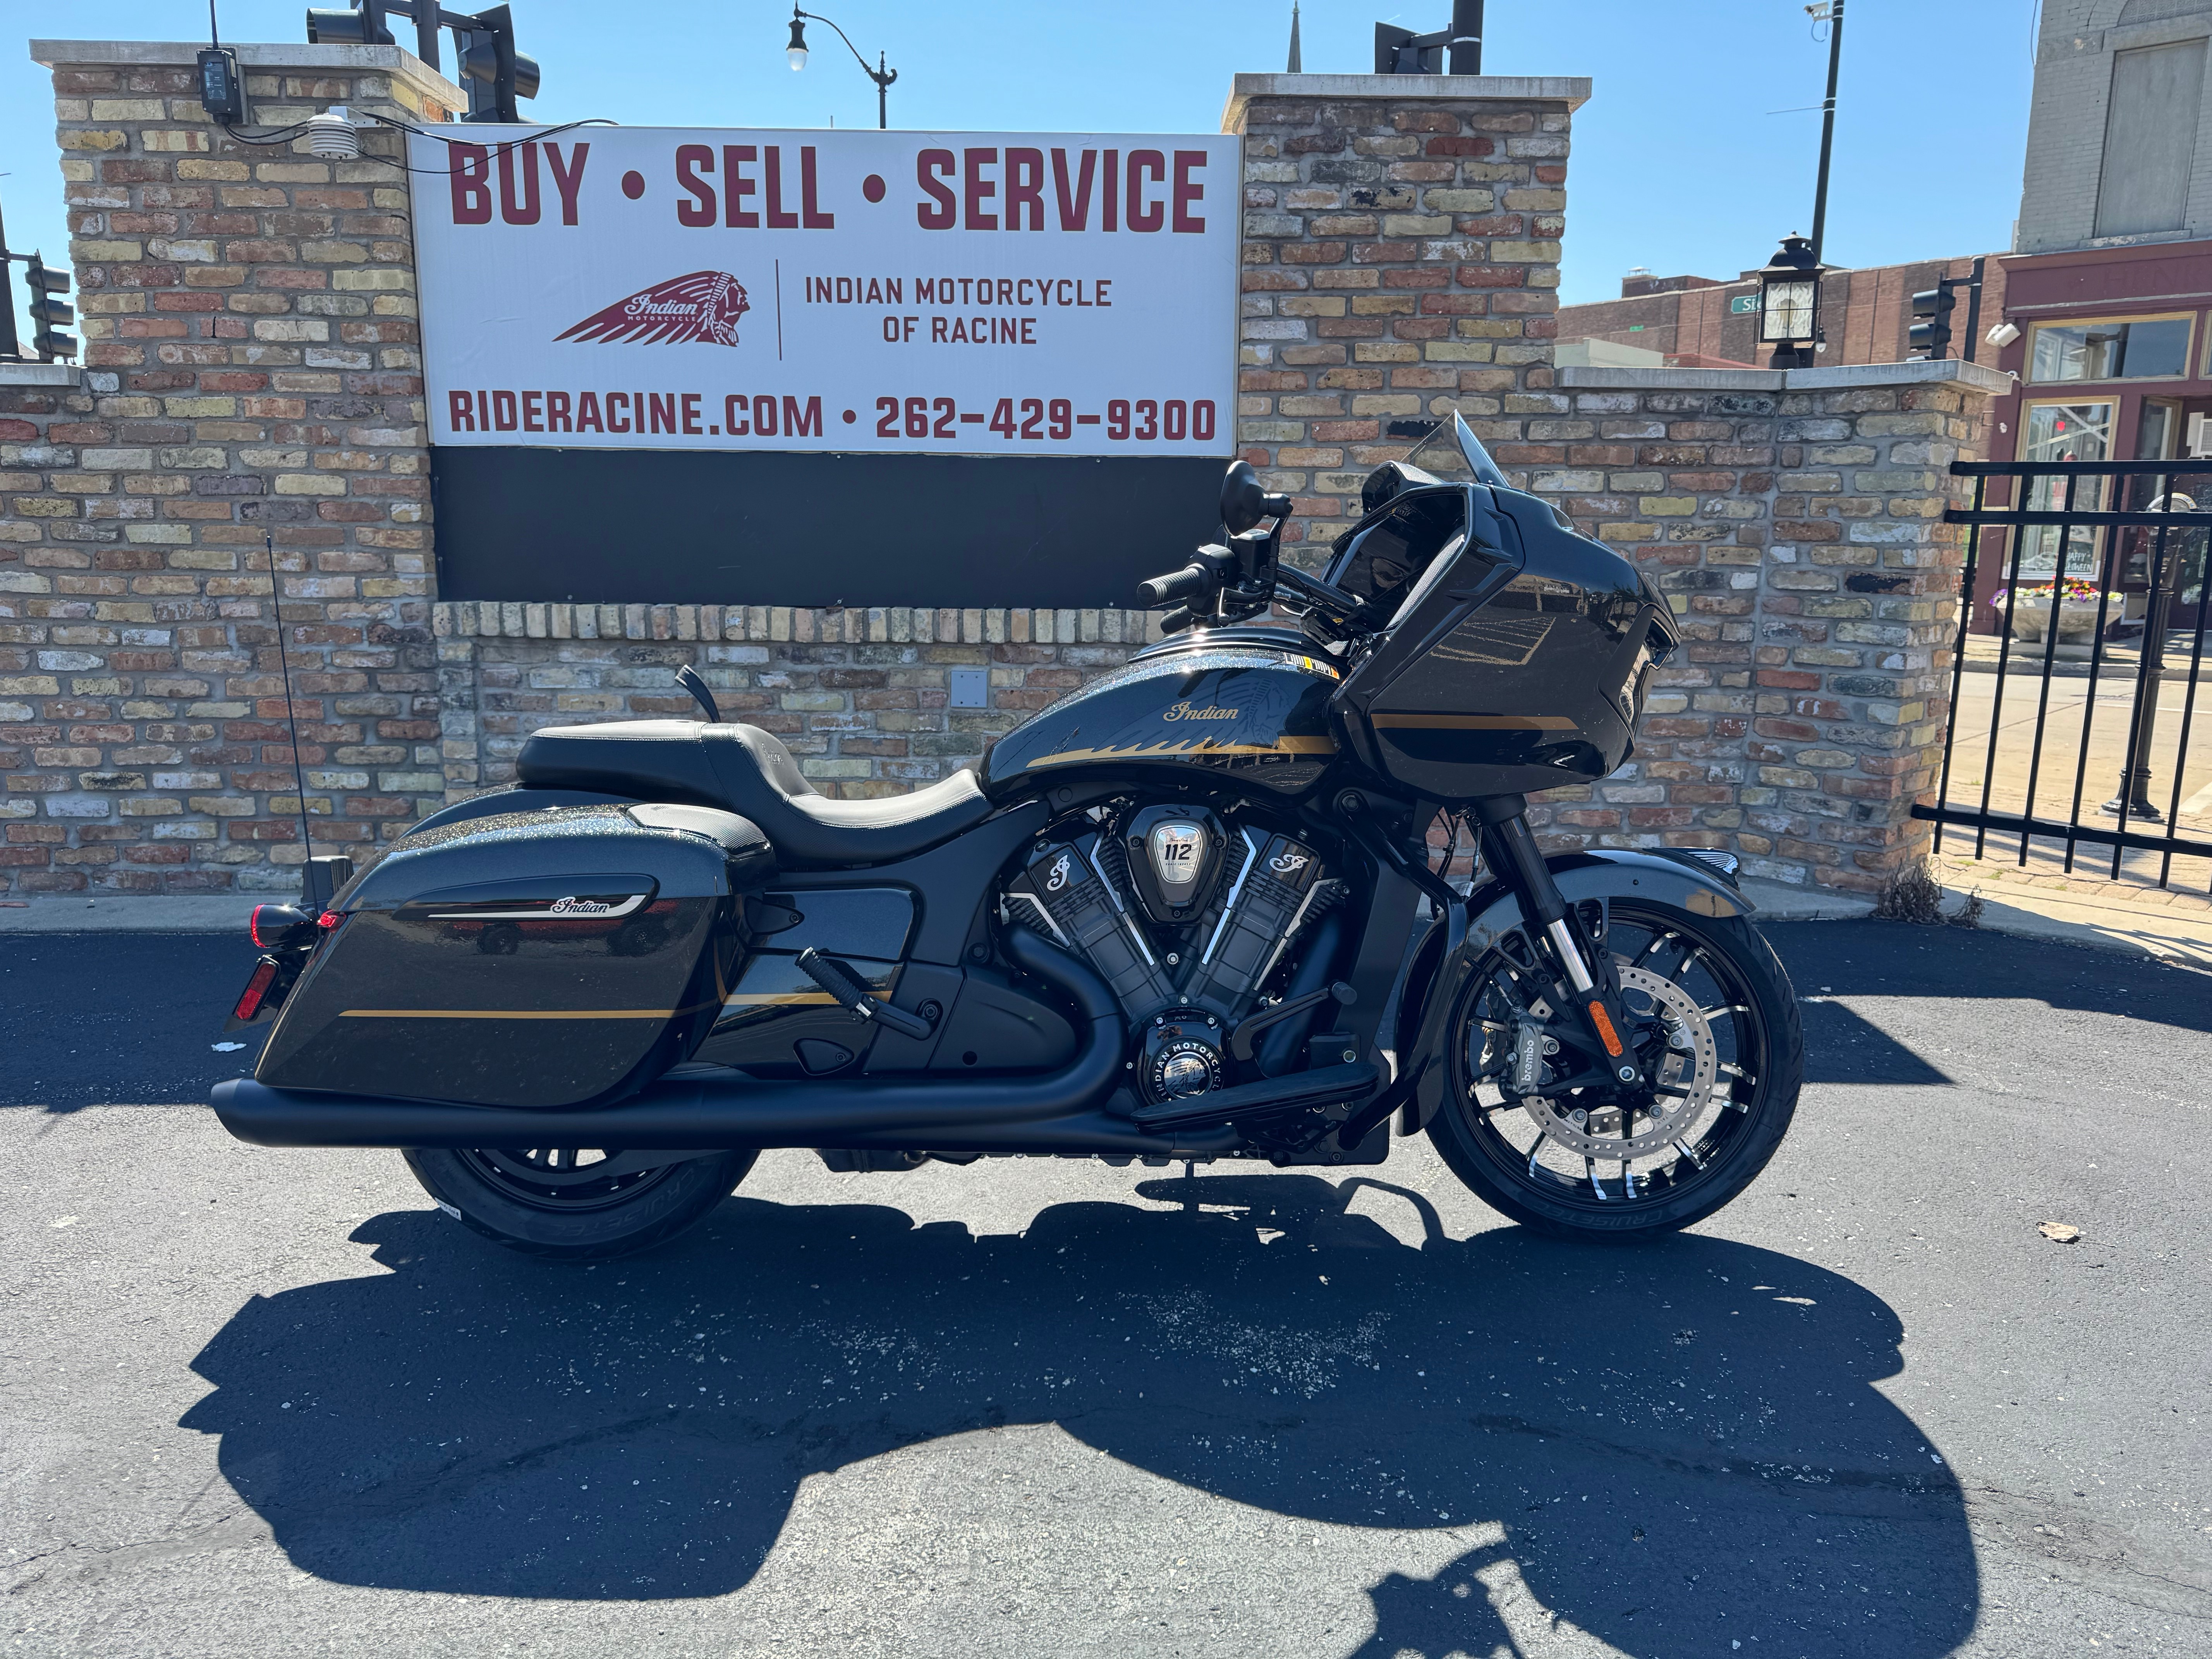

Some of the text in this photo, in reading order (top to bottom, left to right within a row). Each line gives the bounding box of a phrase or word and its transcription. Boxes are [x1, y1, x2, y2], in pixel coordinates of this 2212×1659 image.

[450, 143, 590, 225] BUY
[677, 146, 833, 228] SELL
[918, 149, 1207, 232] SERVICE
[624, 294, 698, 315] Indian
[806, 276, 1112, 307] INDIAN MOTORCYCLE
[883, 316, 1037, 344] OF RACINE
[450, 392, 822, 436] RIDERACINE.COM
[878, 398, 1214, 439] 262-429-9300
[1163, 701, 1238, 721] Indian
[1164, 844, 1192, 860] 112
[552, 898, 608, 913] Indian
[1155, 1042, 1221, 1097] INDIAN MOTORCYCL
[1521, 1040, 1534, 1081] brembo
[1532, 1201, 1663, 1227] CRUISETEC
